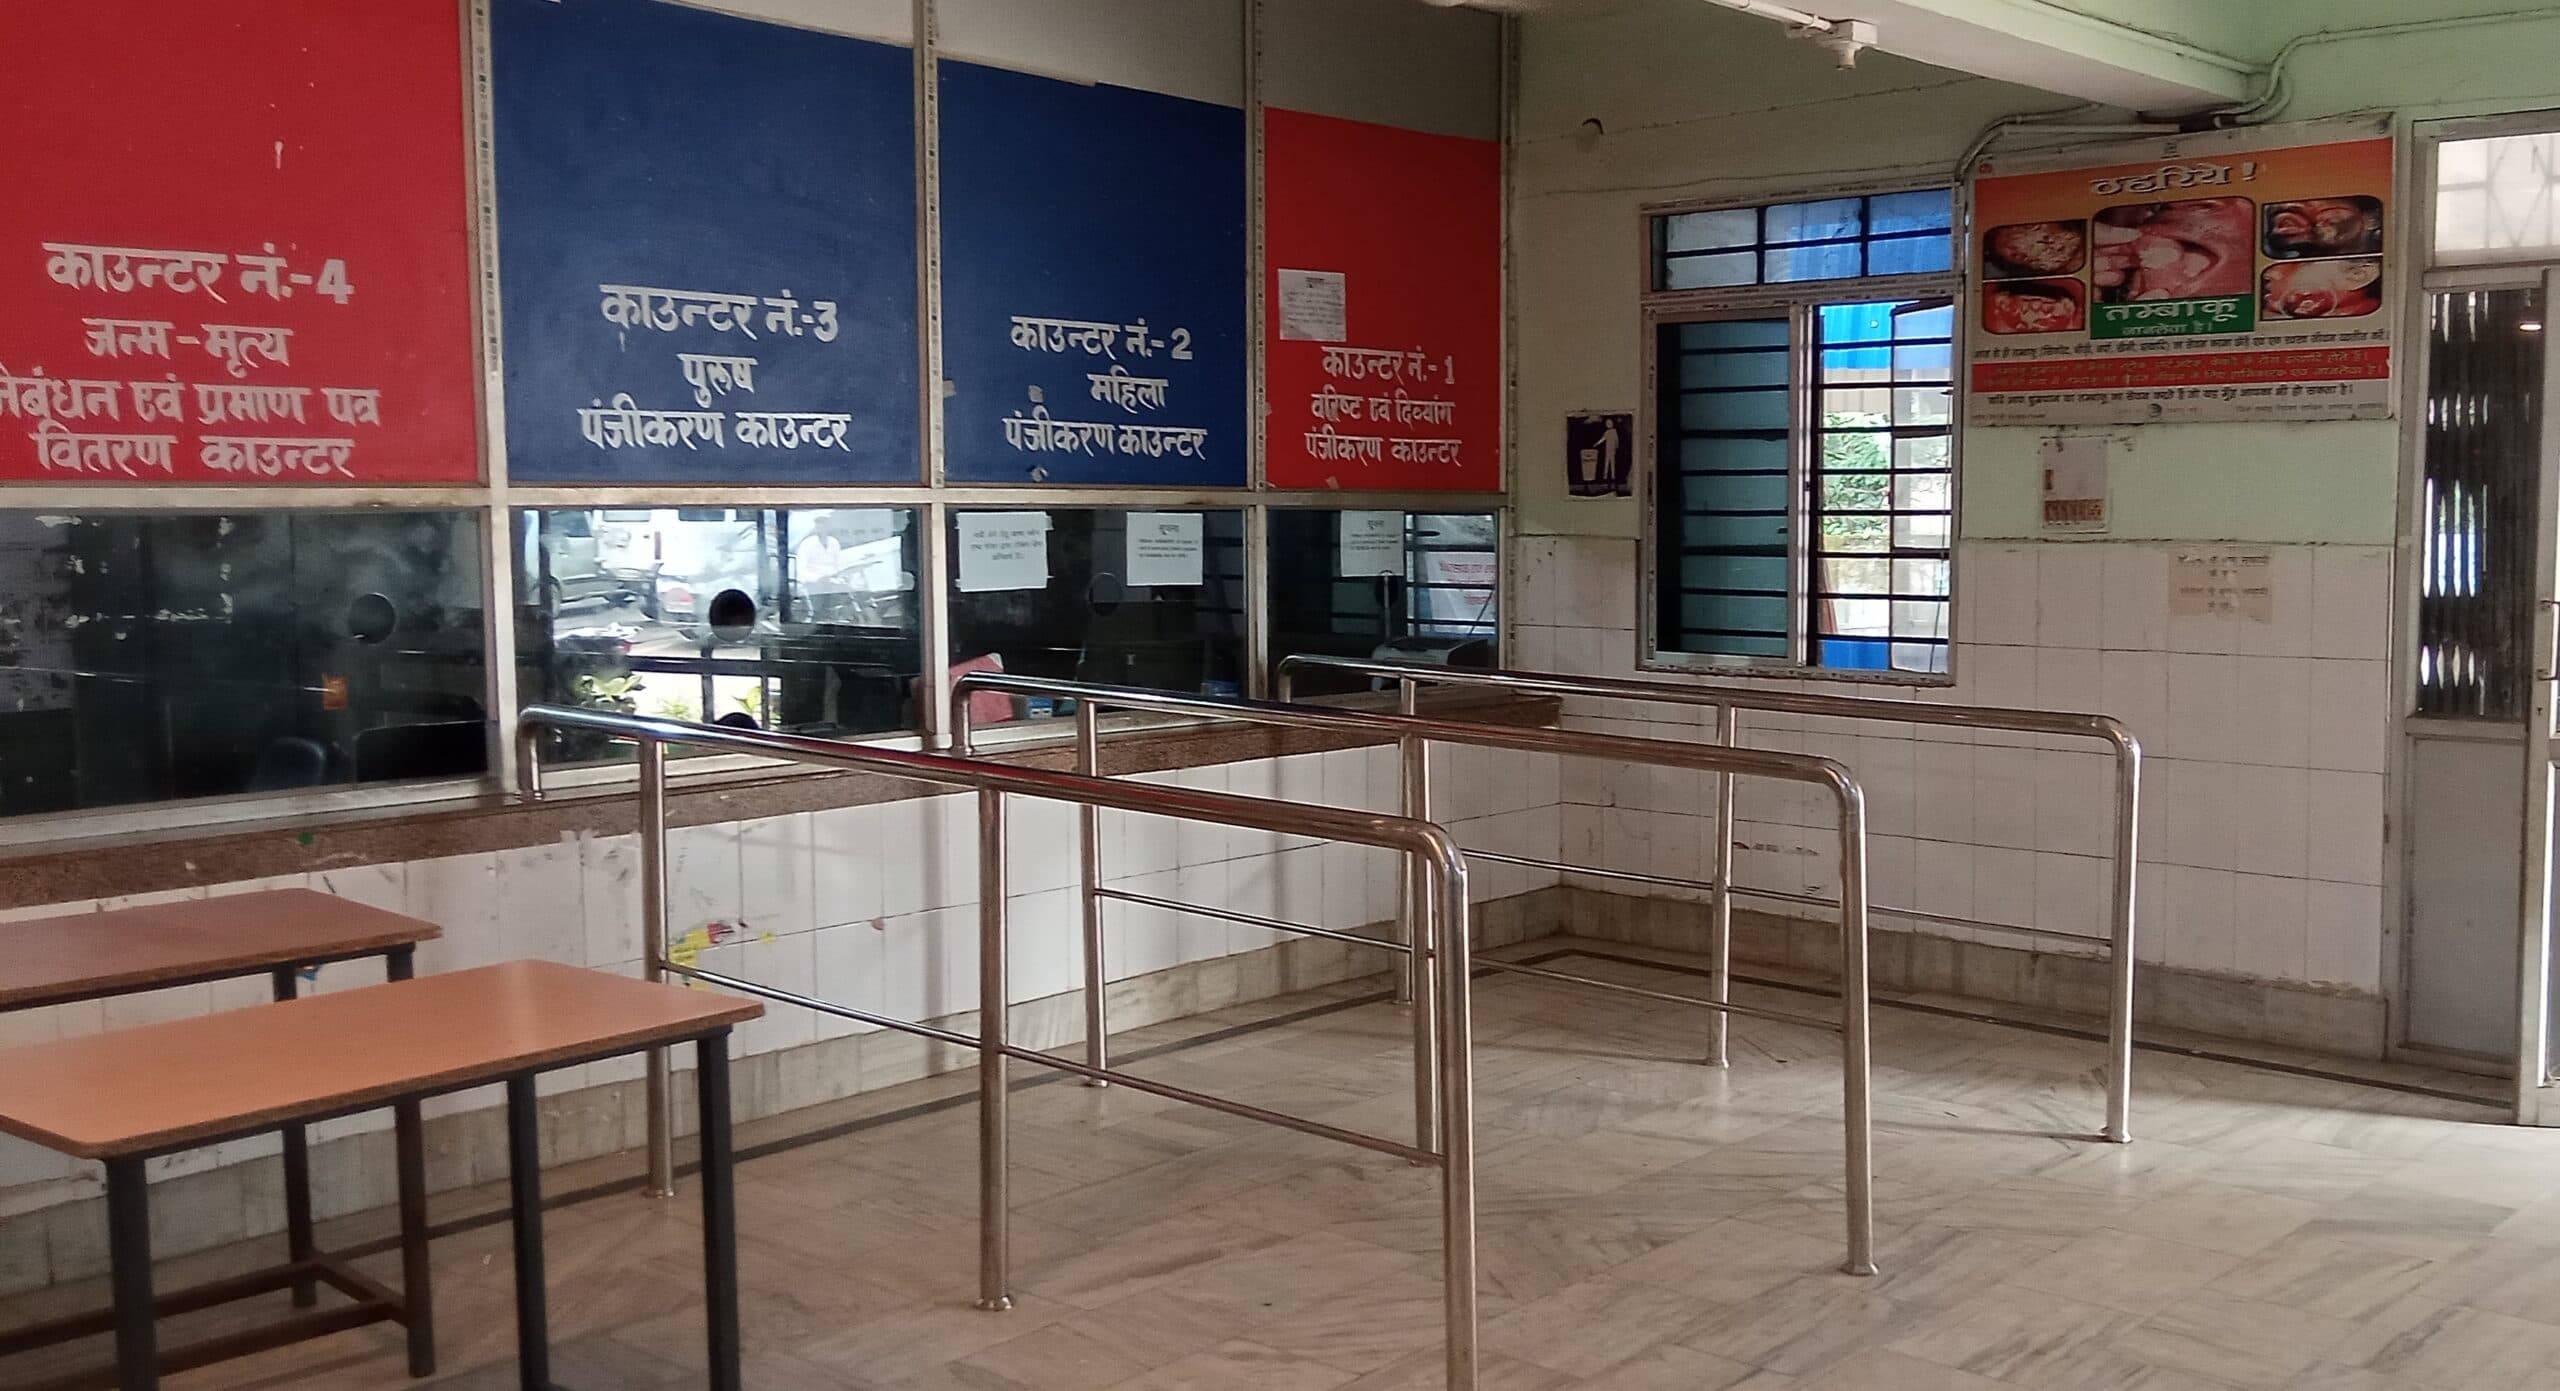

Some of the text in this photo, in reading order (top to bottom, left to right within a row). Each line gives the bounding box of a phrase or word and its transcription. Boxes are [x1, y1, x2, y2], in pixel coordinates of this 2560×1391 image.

[2090, 162, 2232, 196] ठहरिये
[42, 242, 228, 303] काउन्टर
[599, 284, 757, 340] काउन्टर
[2102, 298, 2240, 322] तम्बाकू
[1010, 316, 1120, 360] काउन्टर
[1087, 364, 1169, 414] महिला
[1321, 346, 1405, 385] काउन्टर
[128, 372, 186, 423] एवं
[193, 382, 312, 425] प्रमाण
[321, 386, 382, 427] पत्र
[577, 392, 851, 452] पंजीकरण काउन्टर
[1394, 387, 1456, 430] दिव्यांग
[28, 417, 355, 479] वितरण काउन्टर
[1001, 404, 1208, 460] पंजीकरण काउन्टर
[1304, 423, 1462, 467] पंजीकरण काउन्टर
